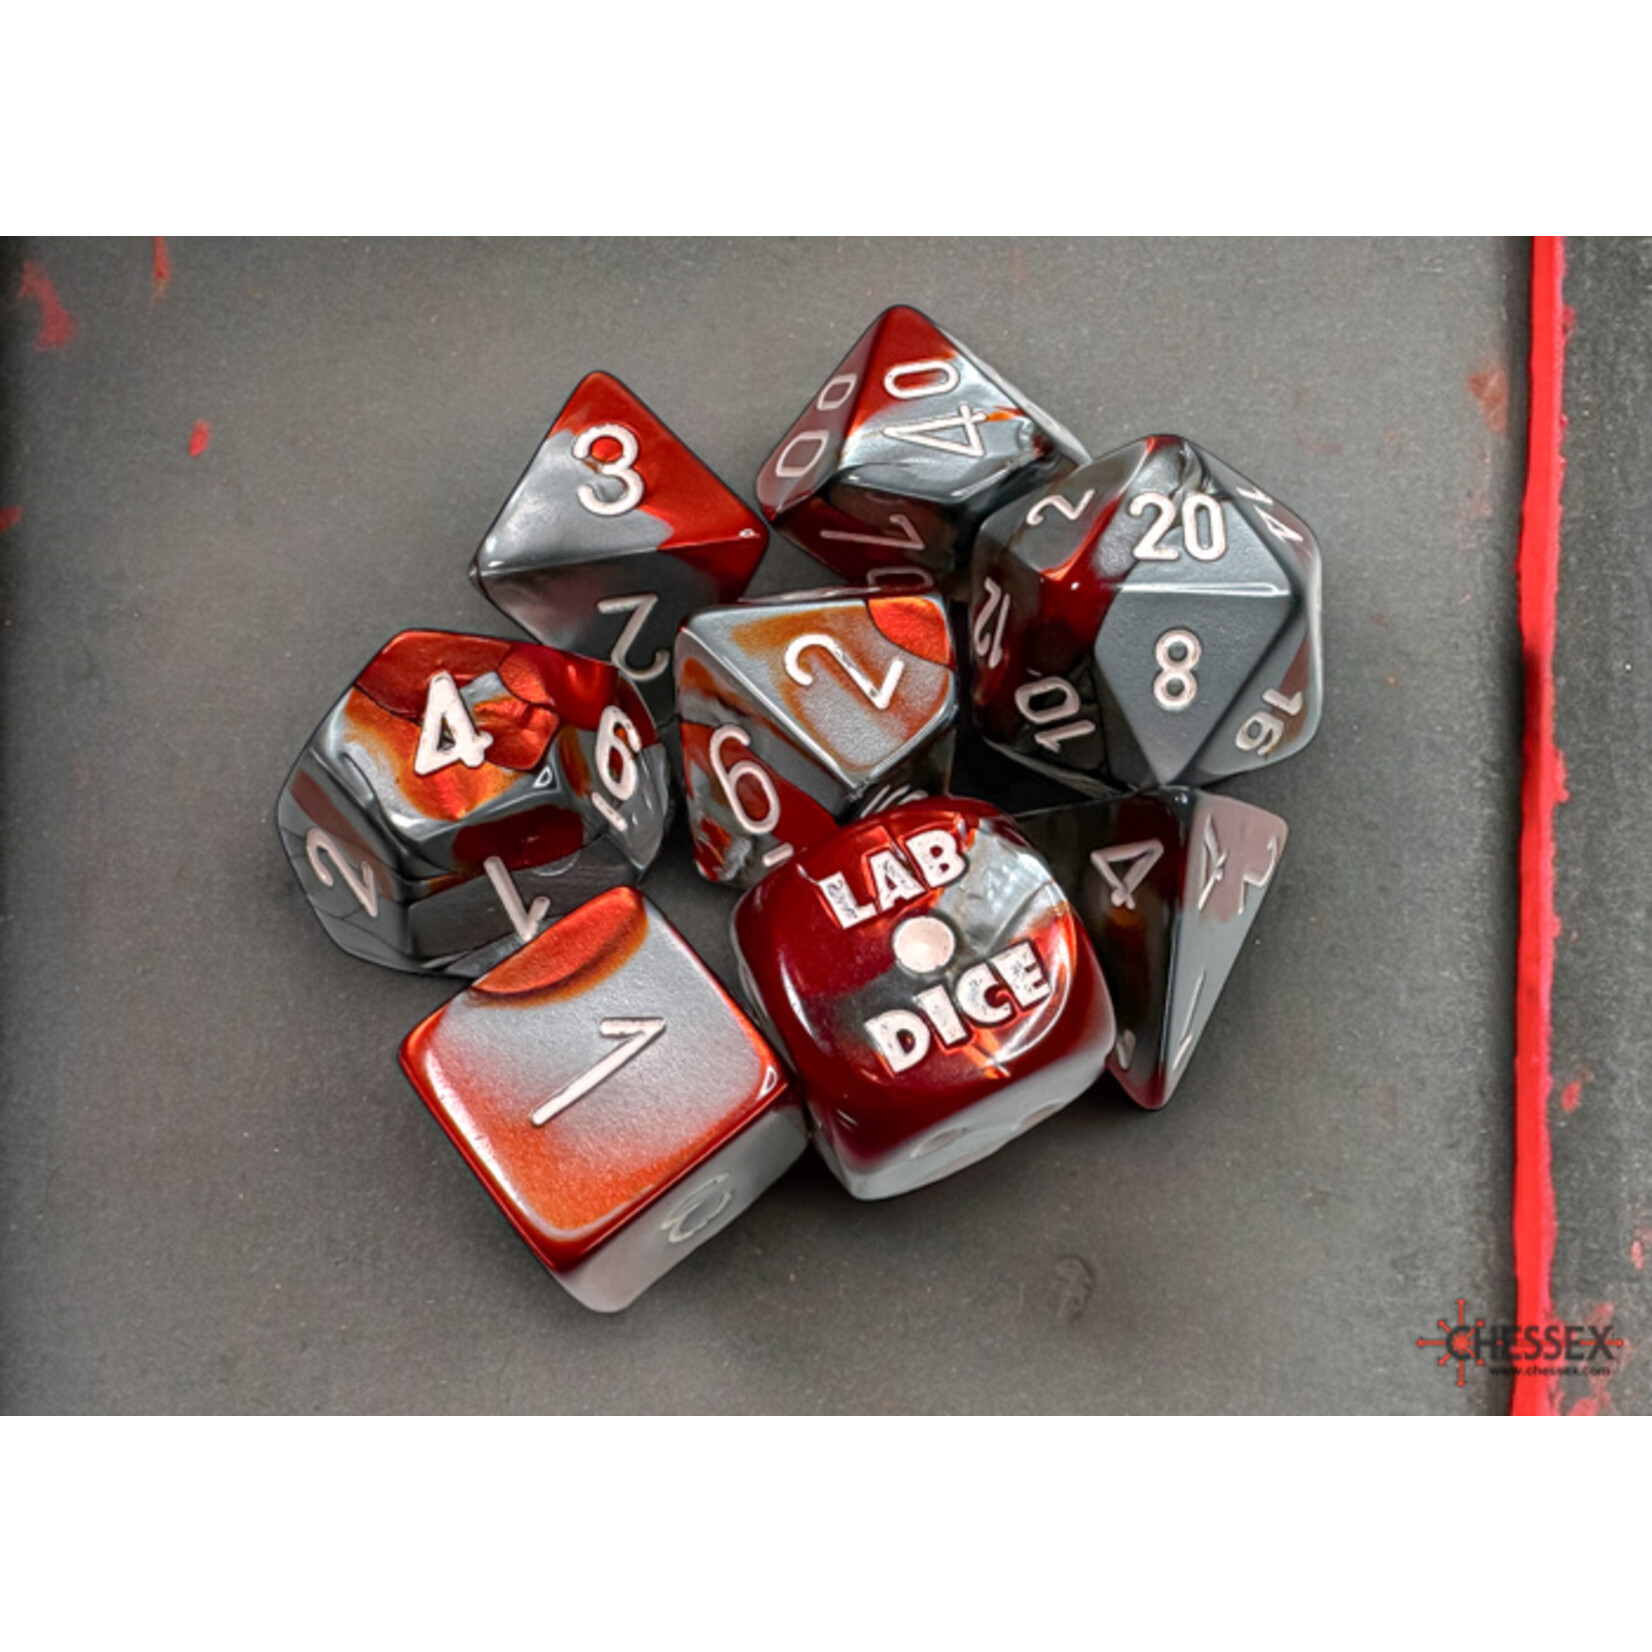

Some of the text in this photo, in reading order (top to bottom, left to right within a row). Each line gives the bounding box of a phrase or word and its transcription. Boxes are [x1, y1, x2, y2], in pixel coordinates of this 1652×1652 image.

[775, 373, 858, 478] 00
[883, 360, 988, 457] 40
[572, 424, 644, 517] 3
[1026, 489, 1096, 527] 2
[1129, 493, 1228, 562] 20
[597, 593, 670, 681] 2
[783, 632, 905, 711] 2
[1153, 629, 1203, 712] 8
[414, 671, 494, 776] 4
[1014, 676, 1096, 753] 10
[306, 827, 378, 918] 2
[818, 829, 968, 930] LAB
[1091, 839, 1165, 910] 4
[864, 939, 1053, 1075] DICE
[532, 1017, 667, 1127] 1
